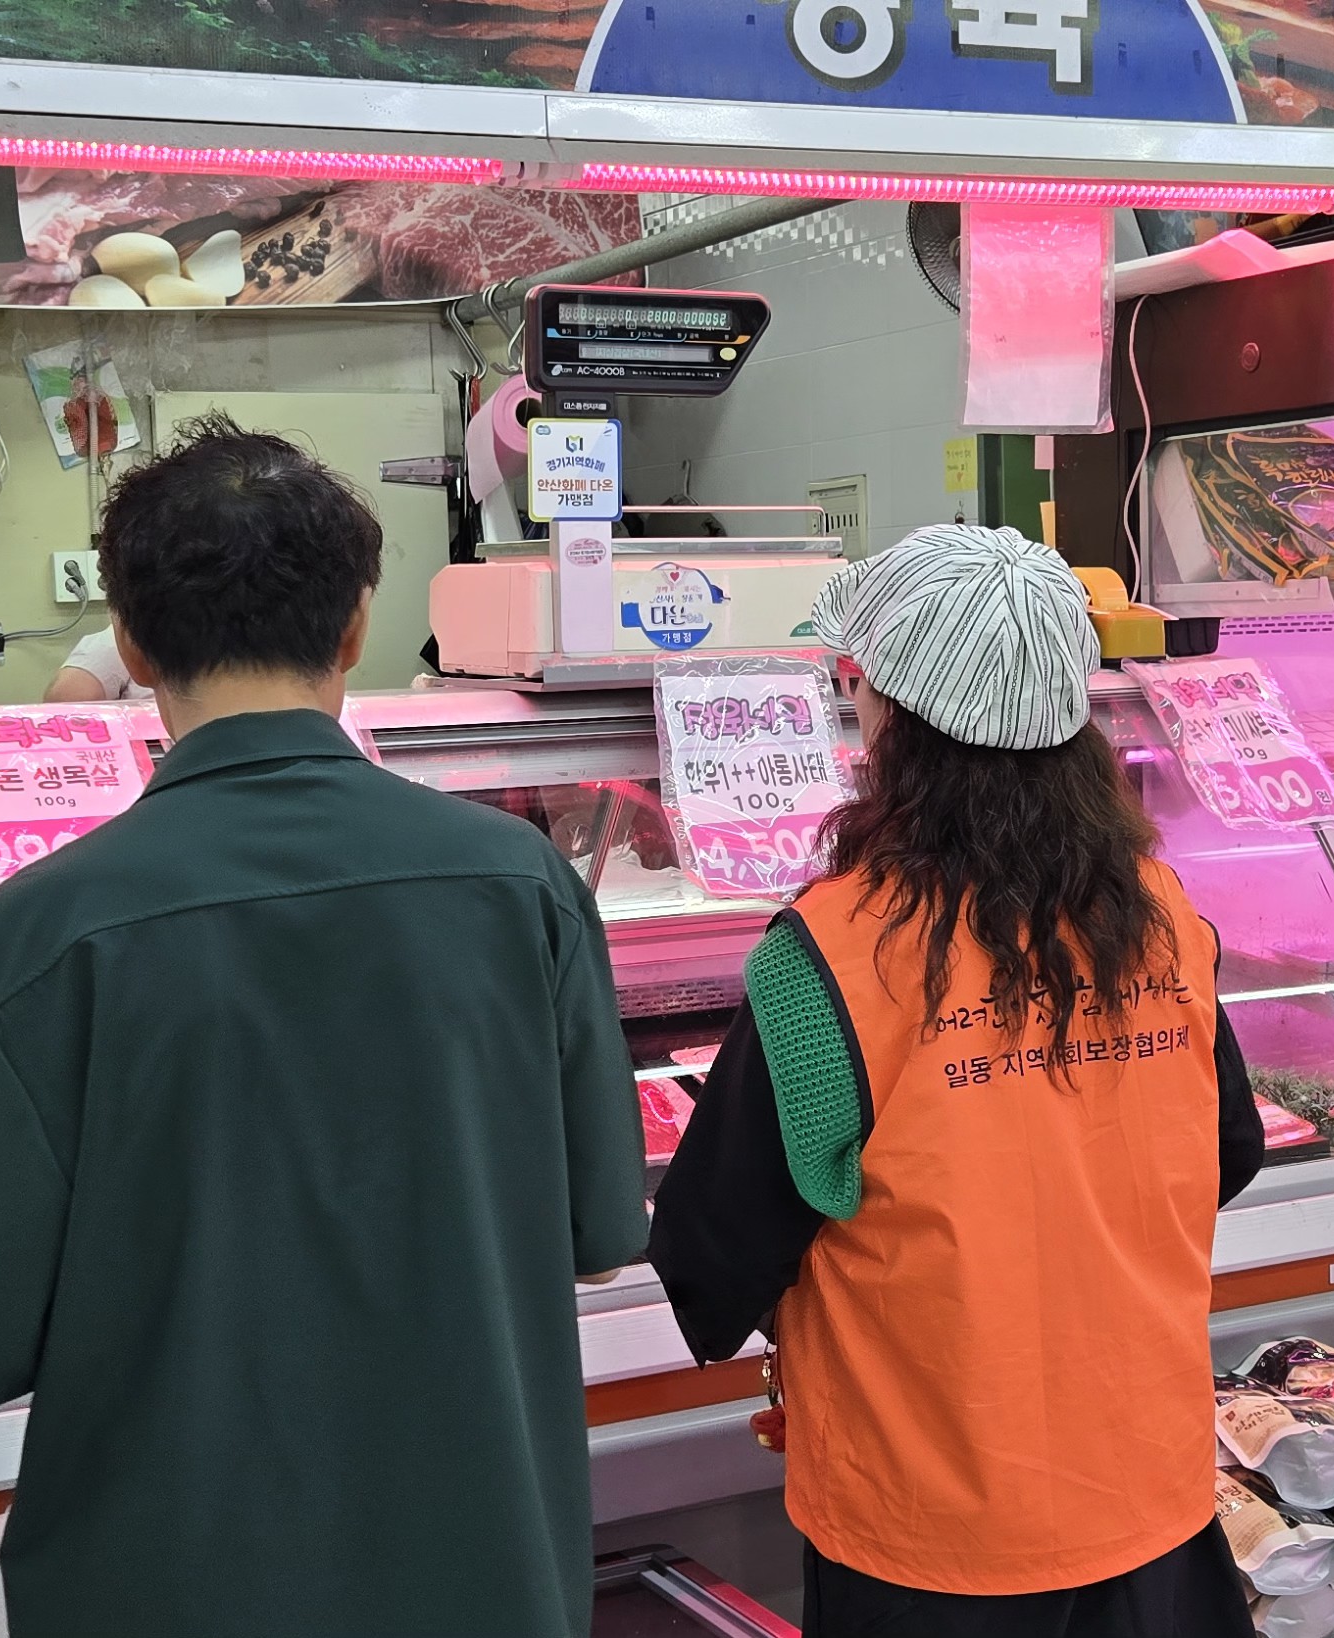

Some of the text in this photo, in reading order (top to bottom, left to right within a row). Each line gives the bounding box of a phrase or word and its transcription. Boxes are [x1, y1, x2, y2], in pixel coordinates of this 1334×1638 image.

[576, 365, 626, 377] AC-4000B
[545, 455, 606, 473] 경기지역화폐
[536, 479, 614, 492] 안산화폐 다온
[557, 493, 595, 507] 가맹점
[661, 631, 692, 644] 가맹점
[76, 748, 116, 764] 국내산
[34, 795, 77, 809] 100g
[732, 792, 796, 813] 100g
[943, 1024, 1191, 1089] 일동 지역사회보장협의체
